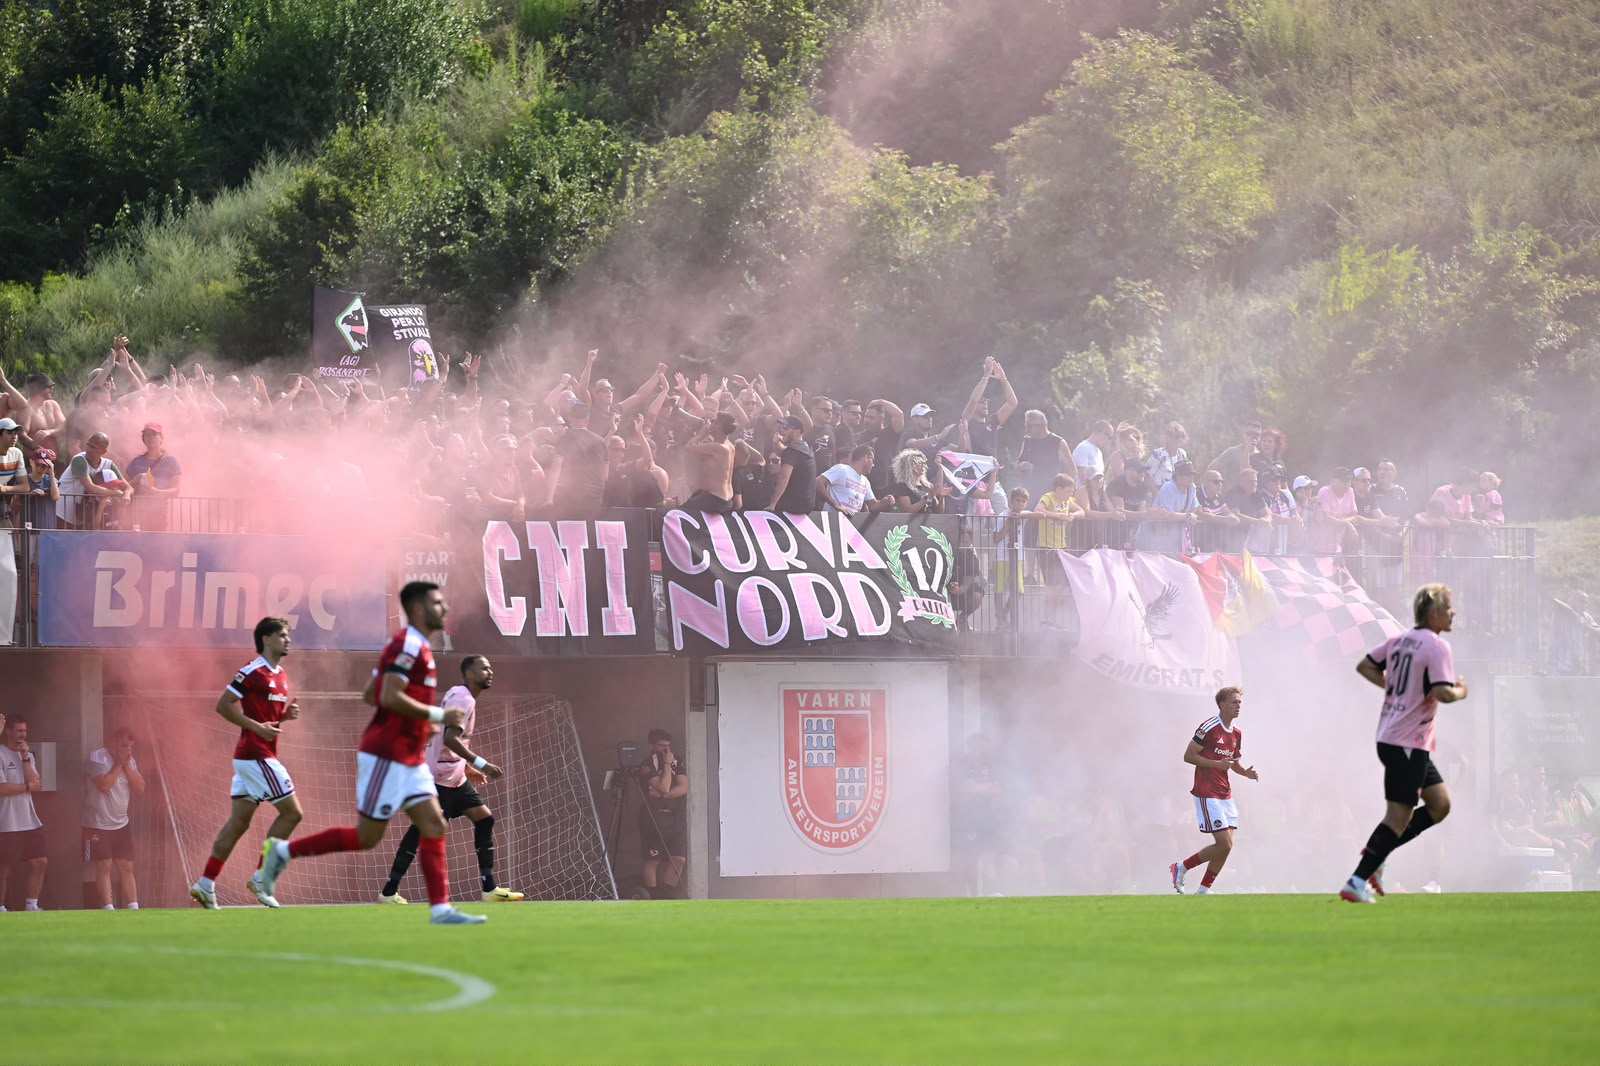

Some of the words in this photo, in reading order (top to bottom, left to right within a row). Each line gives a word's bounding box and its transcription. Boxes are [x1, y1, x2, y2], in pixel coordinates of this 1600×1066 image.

[379, 307, 423, 317] GIRANDO
[391, 317, 415, 328] PER
[415, 317, 425, 327] LO
[393, 328, 431, 340] STIVALE
[340, 355, 360, 366] (AG)
[662, 509, 888, 575] CURVA
[405, 551, 456, 566] START
[93, 551, 337, 631] Brimec
[482, 520, 636, 637] CNI
[667, 571, 892, 650] NORD
[1386, 650, 1413, 697] 20
[797, 692, 872, 708] VAHRN
[788, 757, 884, 844] AMATEURSPORTVEREIN
